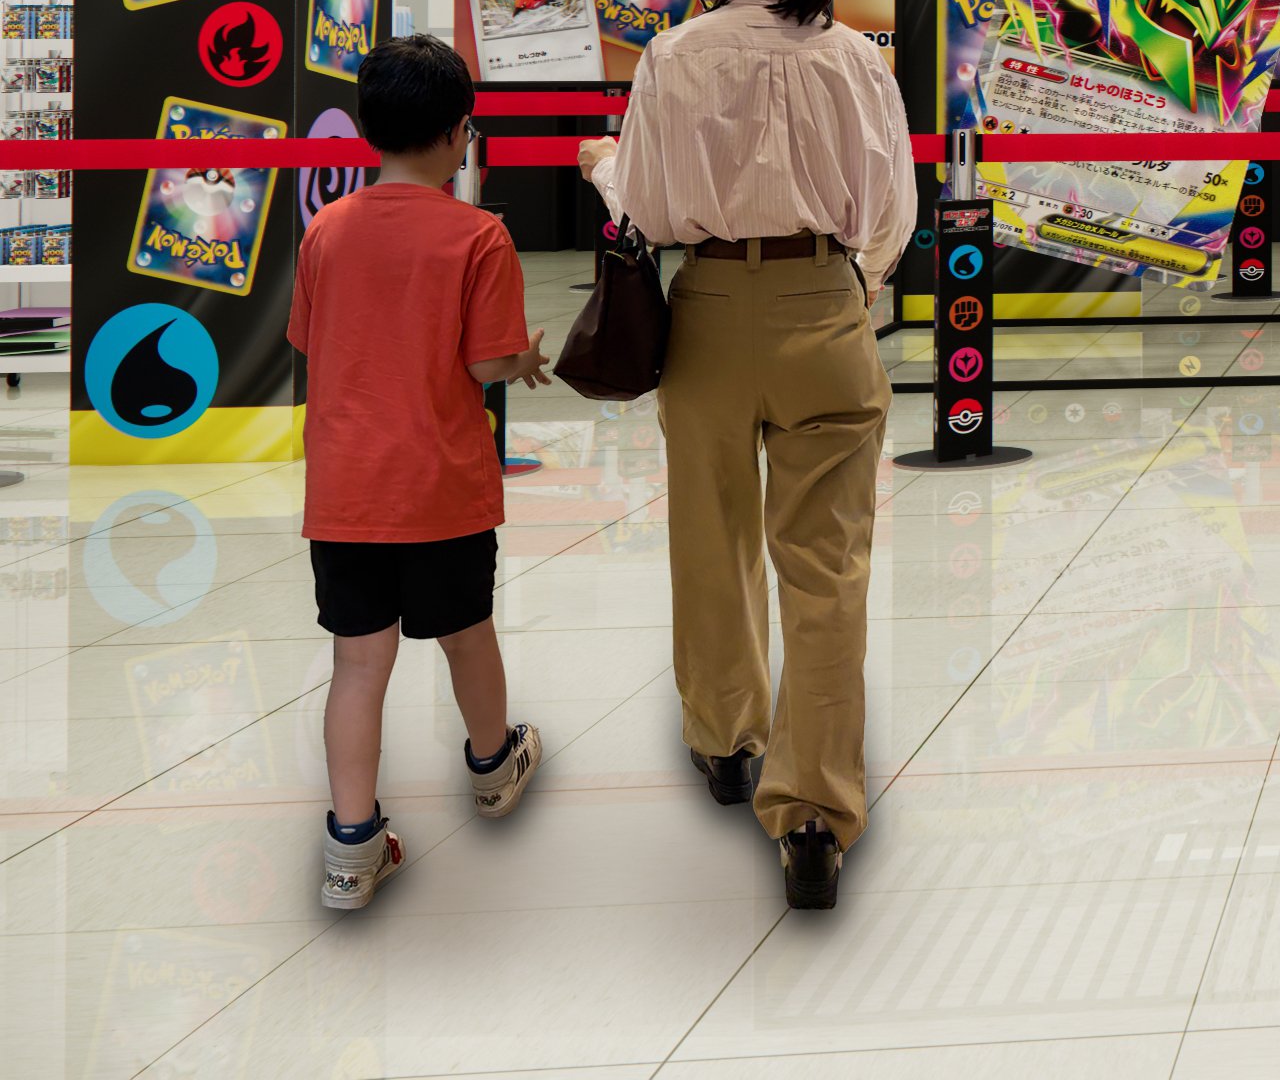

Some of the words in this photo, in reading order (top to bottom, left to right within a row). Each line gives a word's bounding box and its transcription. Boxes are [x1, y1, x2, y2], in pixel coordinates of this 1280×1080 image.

[1069, 74, 1167, 109] はしゃのほうこう
